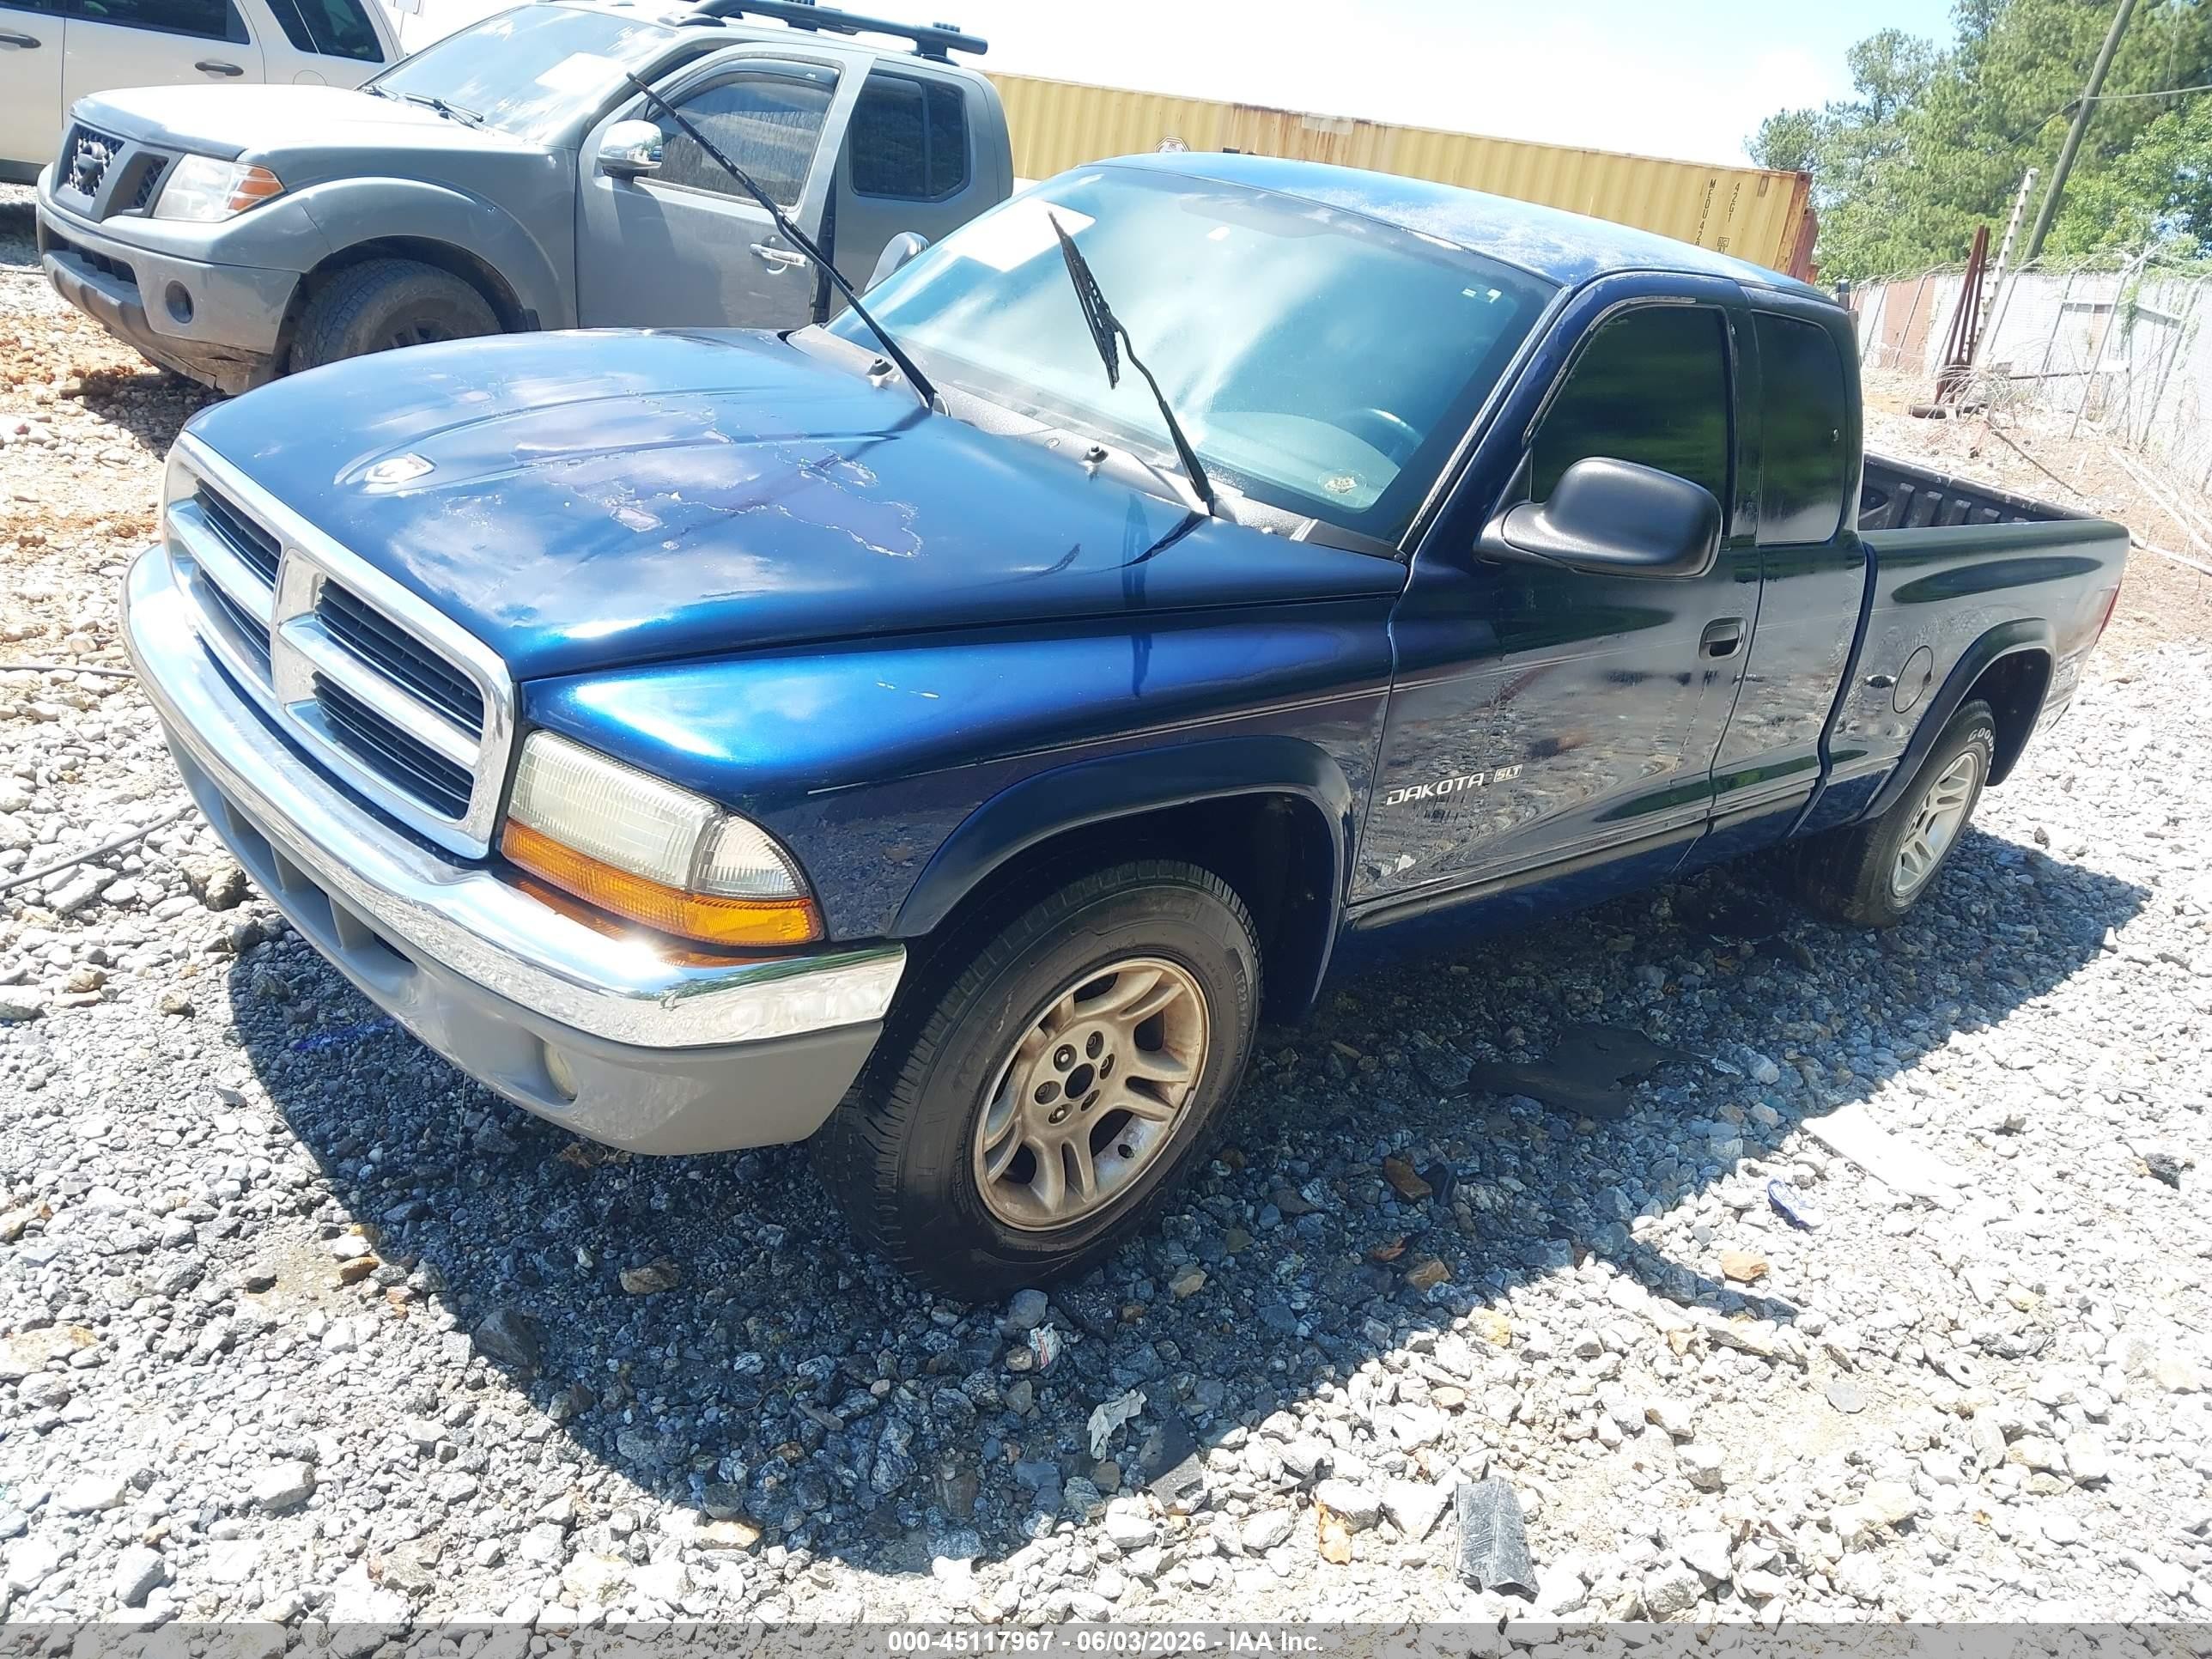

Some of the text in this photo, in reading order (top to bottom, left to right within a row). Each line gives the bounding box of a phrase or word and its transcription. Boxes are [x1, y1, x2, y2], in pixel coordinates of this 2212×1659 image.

[1728, 181, 1741, 223] 42G1
[1386, 765, 1522, 805] DAKOTA SLT
